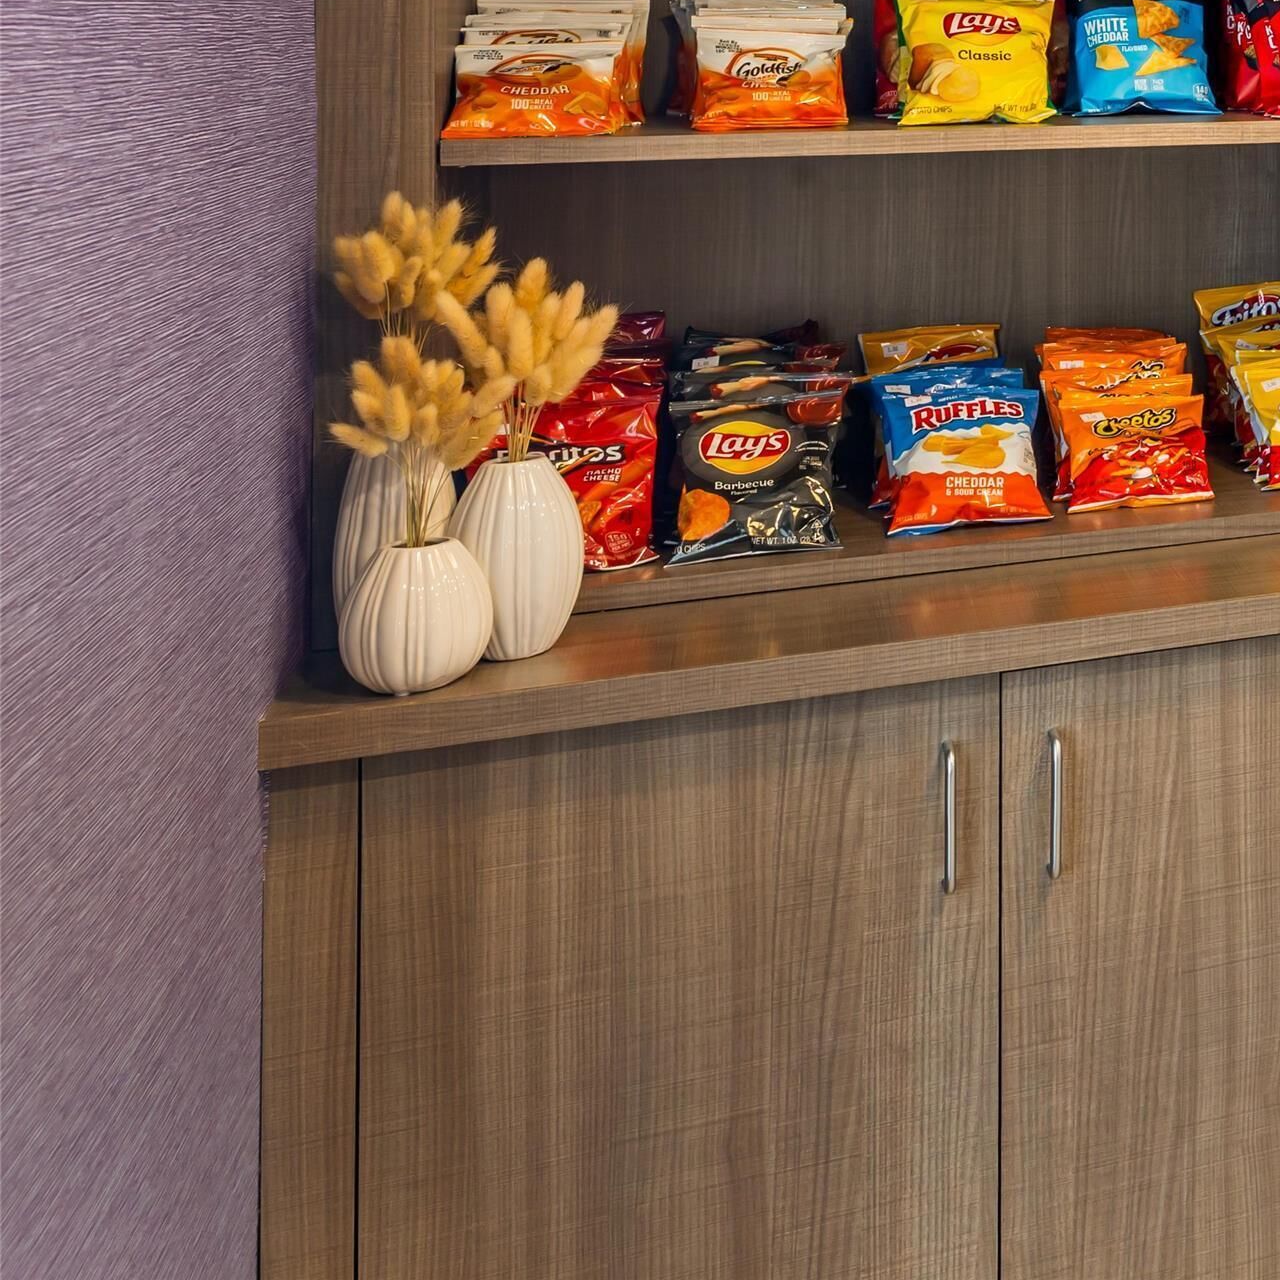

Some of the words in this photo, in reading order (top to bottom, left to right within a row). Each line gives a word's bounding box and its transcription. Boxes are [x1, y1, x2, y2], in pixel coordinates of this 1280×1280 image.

[949, 13, 1017, 34] Lay's
[1084, 18, 1128, 36] WHITE
[1087, 31, 1129, 48] CHEDDAR
[958, 49, 1012, 61] Classic
[736, 62, 802, 80] Goldfish
[501, 85, 569, 95] CHEDDAR
[912, 399, 1023, 434] RUFFLES
[1092, 408, 1176, 438] Cheetos
[706, 433, 784, 461] Lay's
[587, 468, 622, 476] NACHO
[715, 480, 774, 490] Barbecue
[946, 477, 1004, 488] CHEDDAR
[954, 488, 974, 496] SOUR
